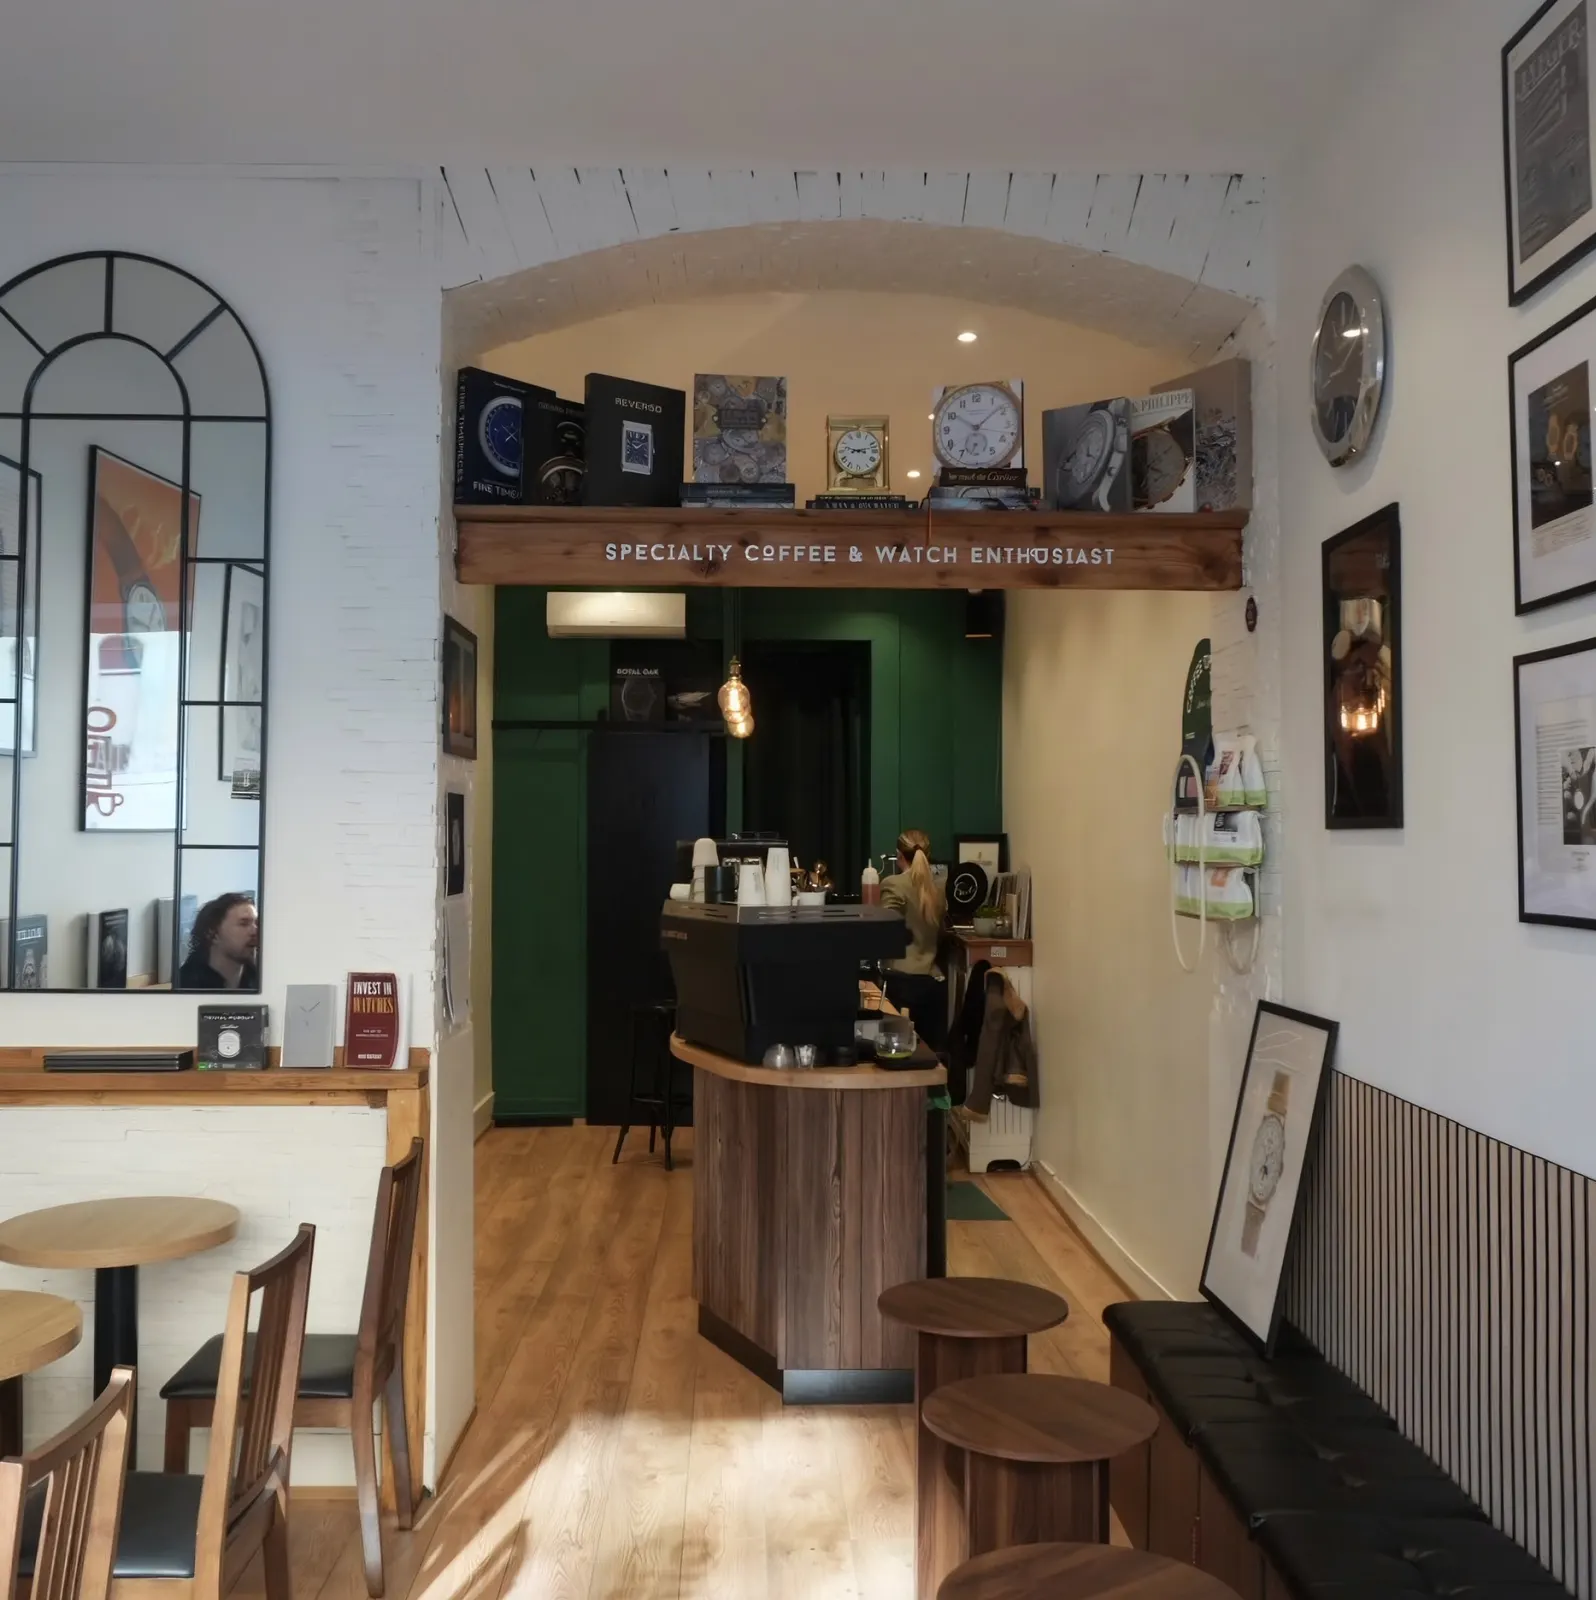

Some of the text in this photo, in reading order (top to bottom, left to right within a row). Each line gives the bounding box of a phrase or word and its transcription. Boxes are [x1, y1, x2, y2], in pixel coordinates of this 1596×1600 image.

[614, 397, 663, 413] REVERSO
[472, 481, 493, 495] FINE
[605, 543, 1114, 565] SPECIALTY COFFEE & WATCH ENTHUSIAST
[353, 981, 392, 995] INVEST IN
[353, 997, 394, 1014] WATCHES
